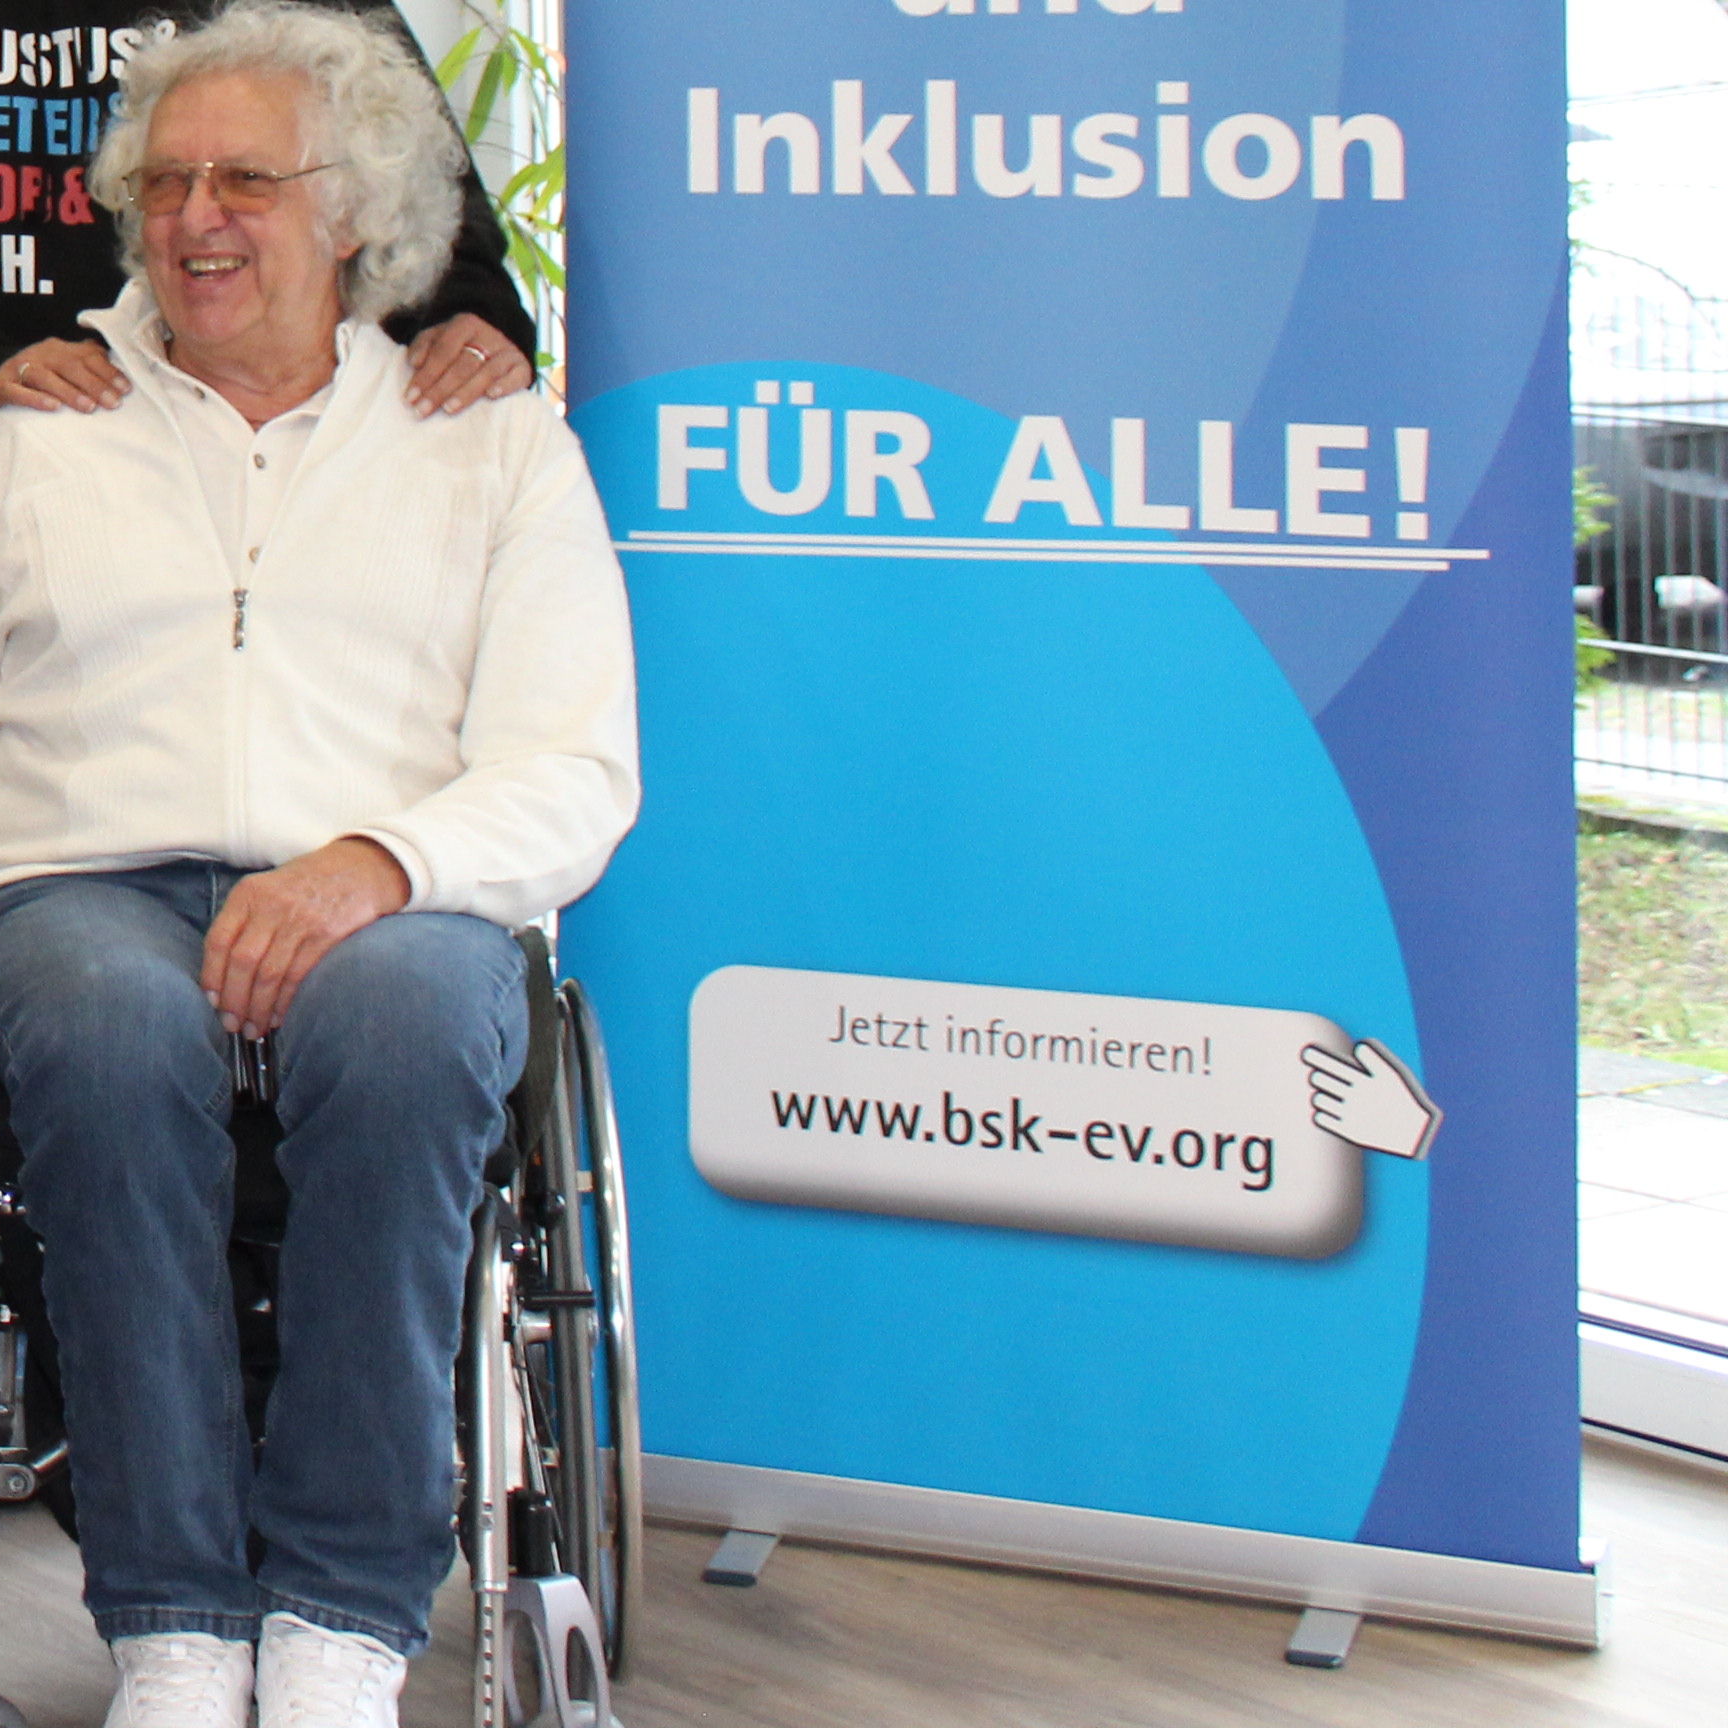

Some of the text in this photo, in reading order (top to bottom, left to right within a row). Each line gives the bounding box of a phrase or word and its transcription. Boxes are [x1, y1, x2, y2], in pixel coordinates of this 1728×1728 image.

[685, 79, 1406, 201] Inklusion
[655, 380, 1431, 541] FÜR ALLE!
[828, 1005, 1214, 1076] Jetzt informieren!
[770, 1089, 1275, 1191] www.bsk-ev.org
